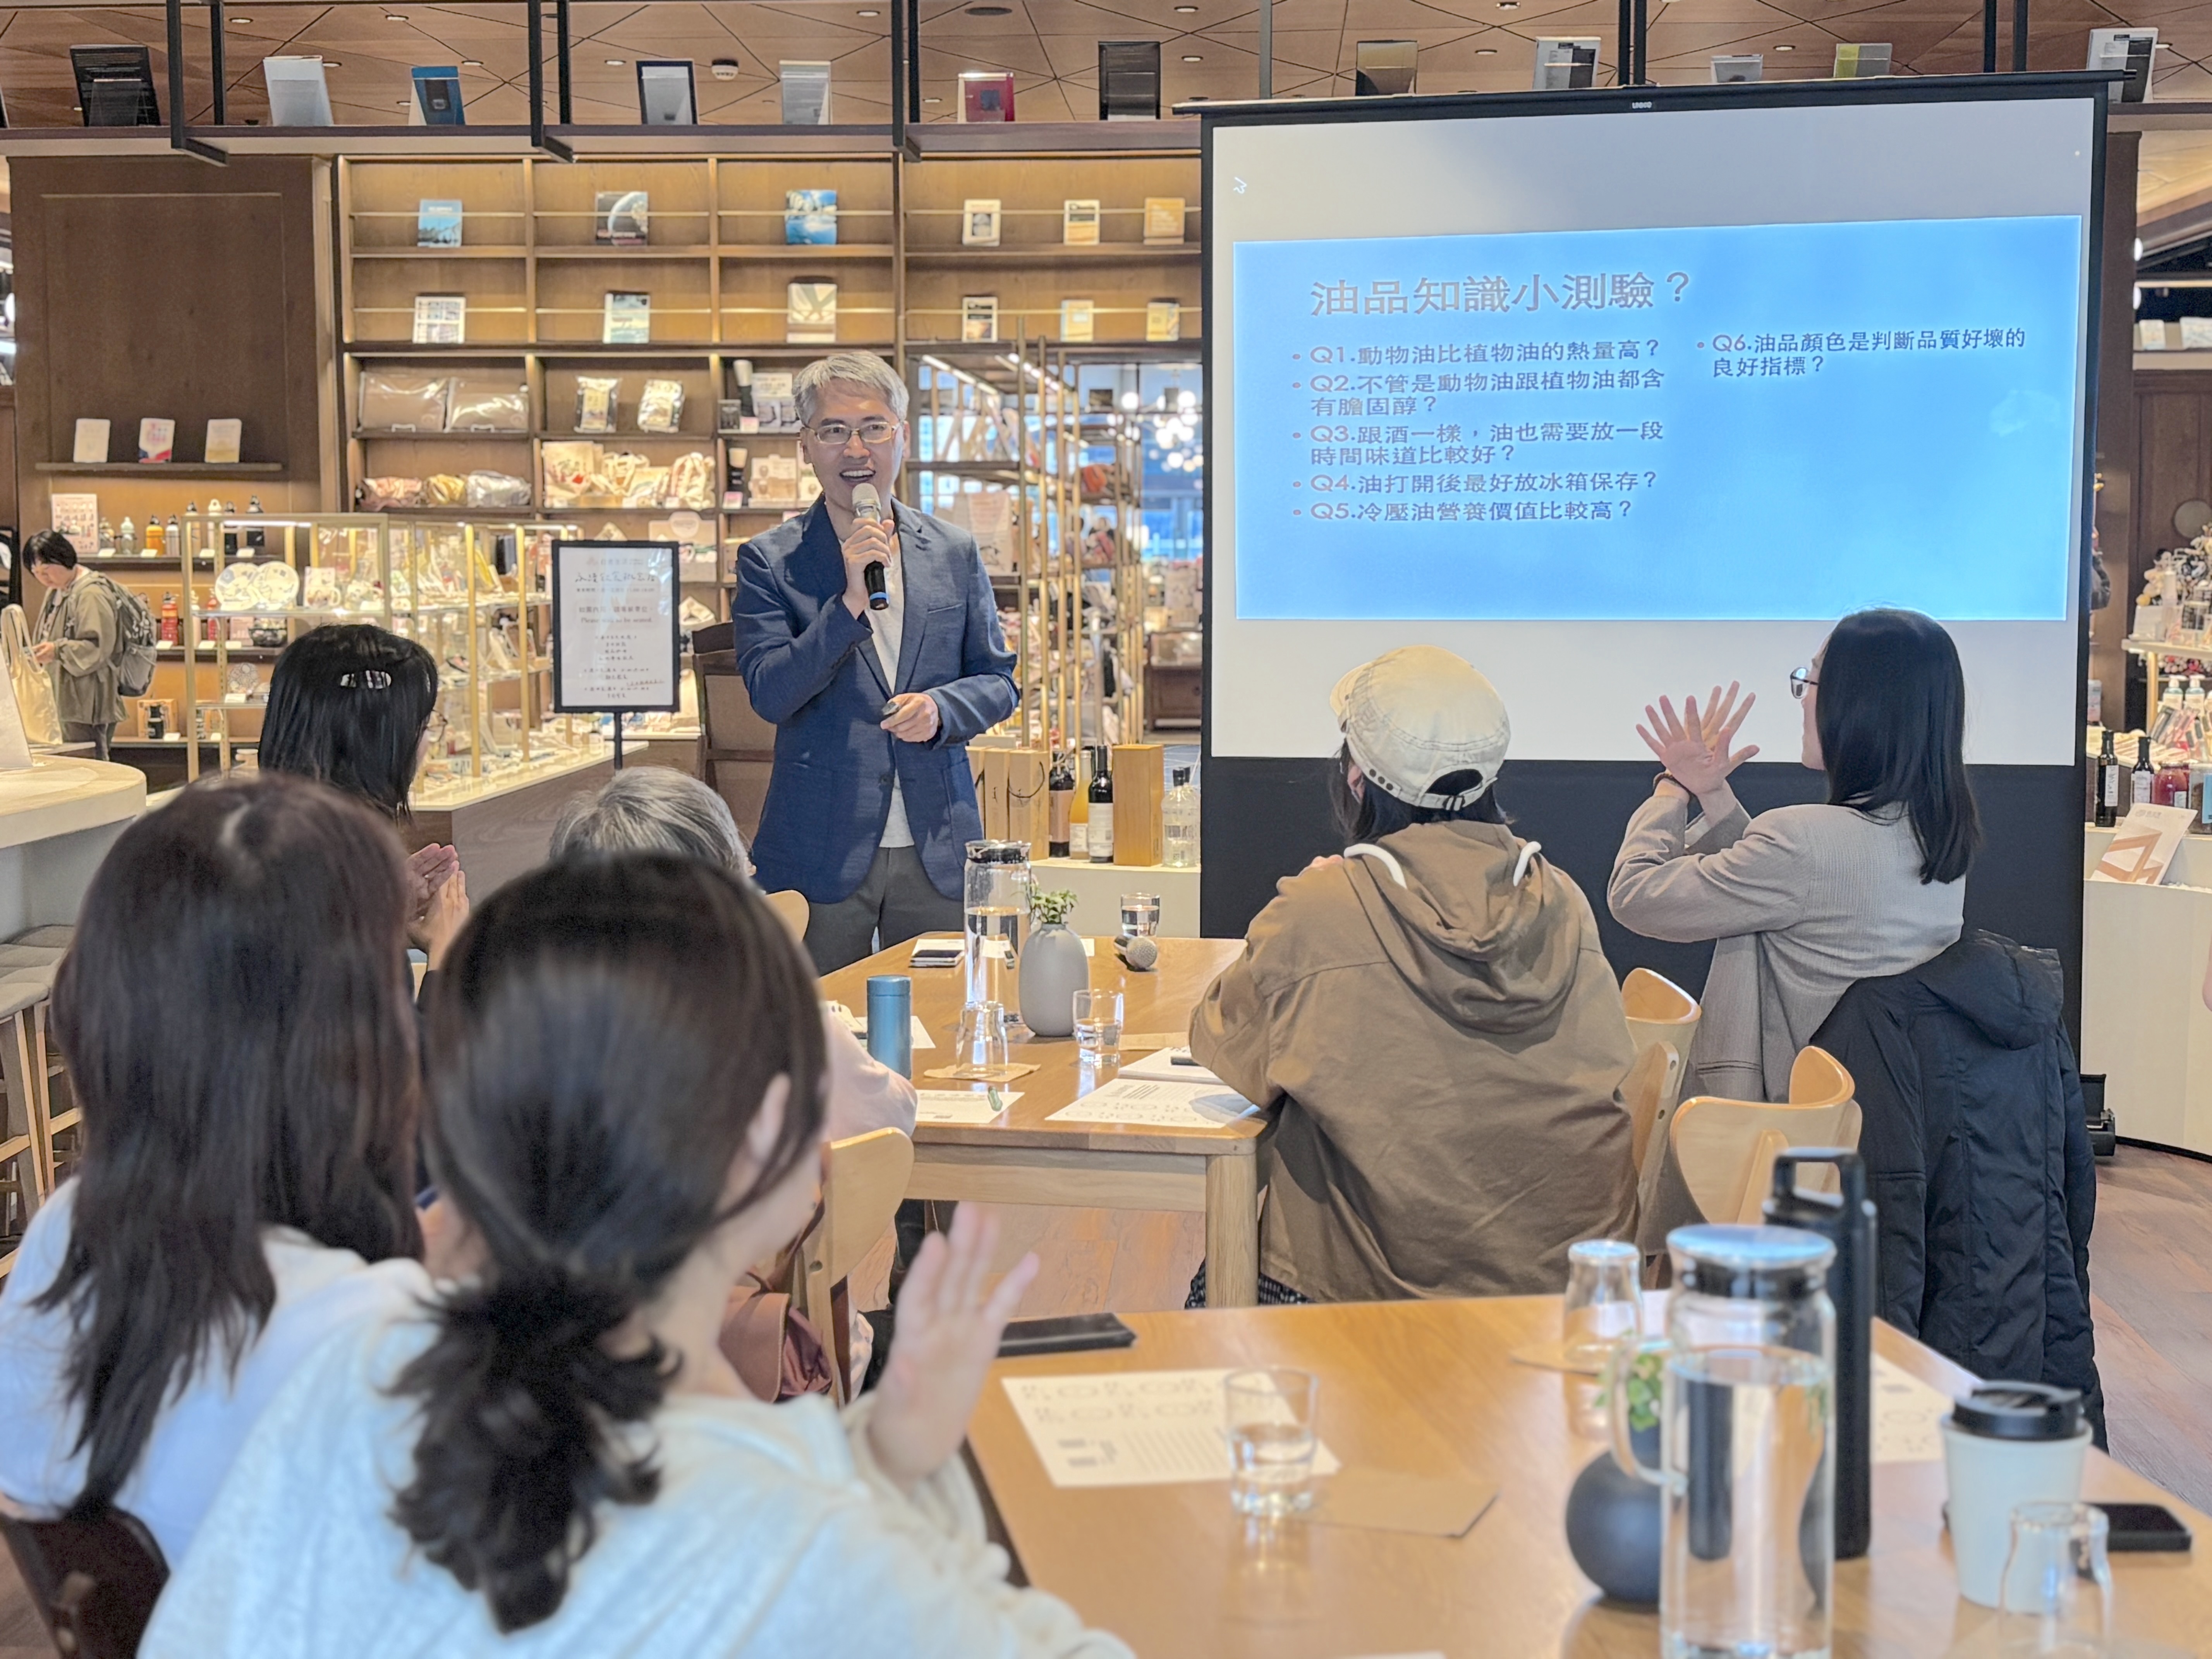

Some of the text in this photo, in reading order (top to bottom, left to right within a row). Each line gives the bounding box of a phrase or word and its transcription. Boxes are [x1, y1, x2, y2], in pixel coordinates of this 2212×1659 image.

[1310, 272, 1688, 316] 油品知識小測驗？
[1712, 328, 2025, 353] Q6.油品顏色是判斷品質好壞的
[1310, 339, 1659, 366] Q1.動物油比植物油的熱量高？
[1713, 355, 1824, 378] 良好指標？
[1310, 368, 1664, 394] Q2.不管是動物油跟植物油都含
[1311, 396, 1436, 416] 有膽固醇？
[1310, 421, 1663, 444] Q3.跟酒一樣，油也需要放一段
[1311, 445, 1514, 466] 時間味道比較好？
[1311, 471, 1656, 493] Q4.油打開後最好放冰箱保存？
[1311, 500, 1632, 522] Q5.冷壓油營養價值比較高？
